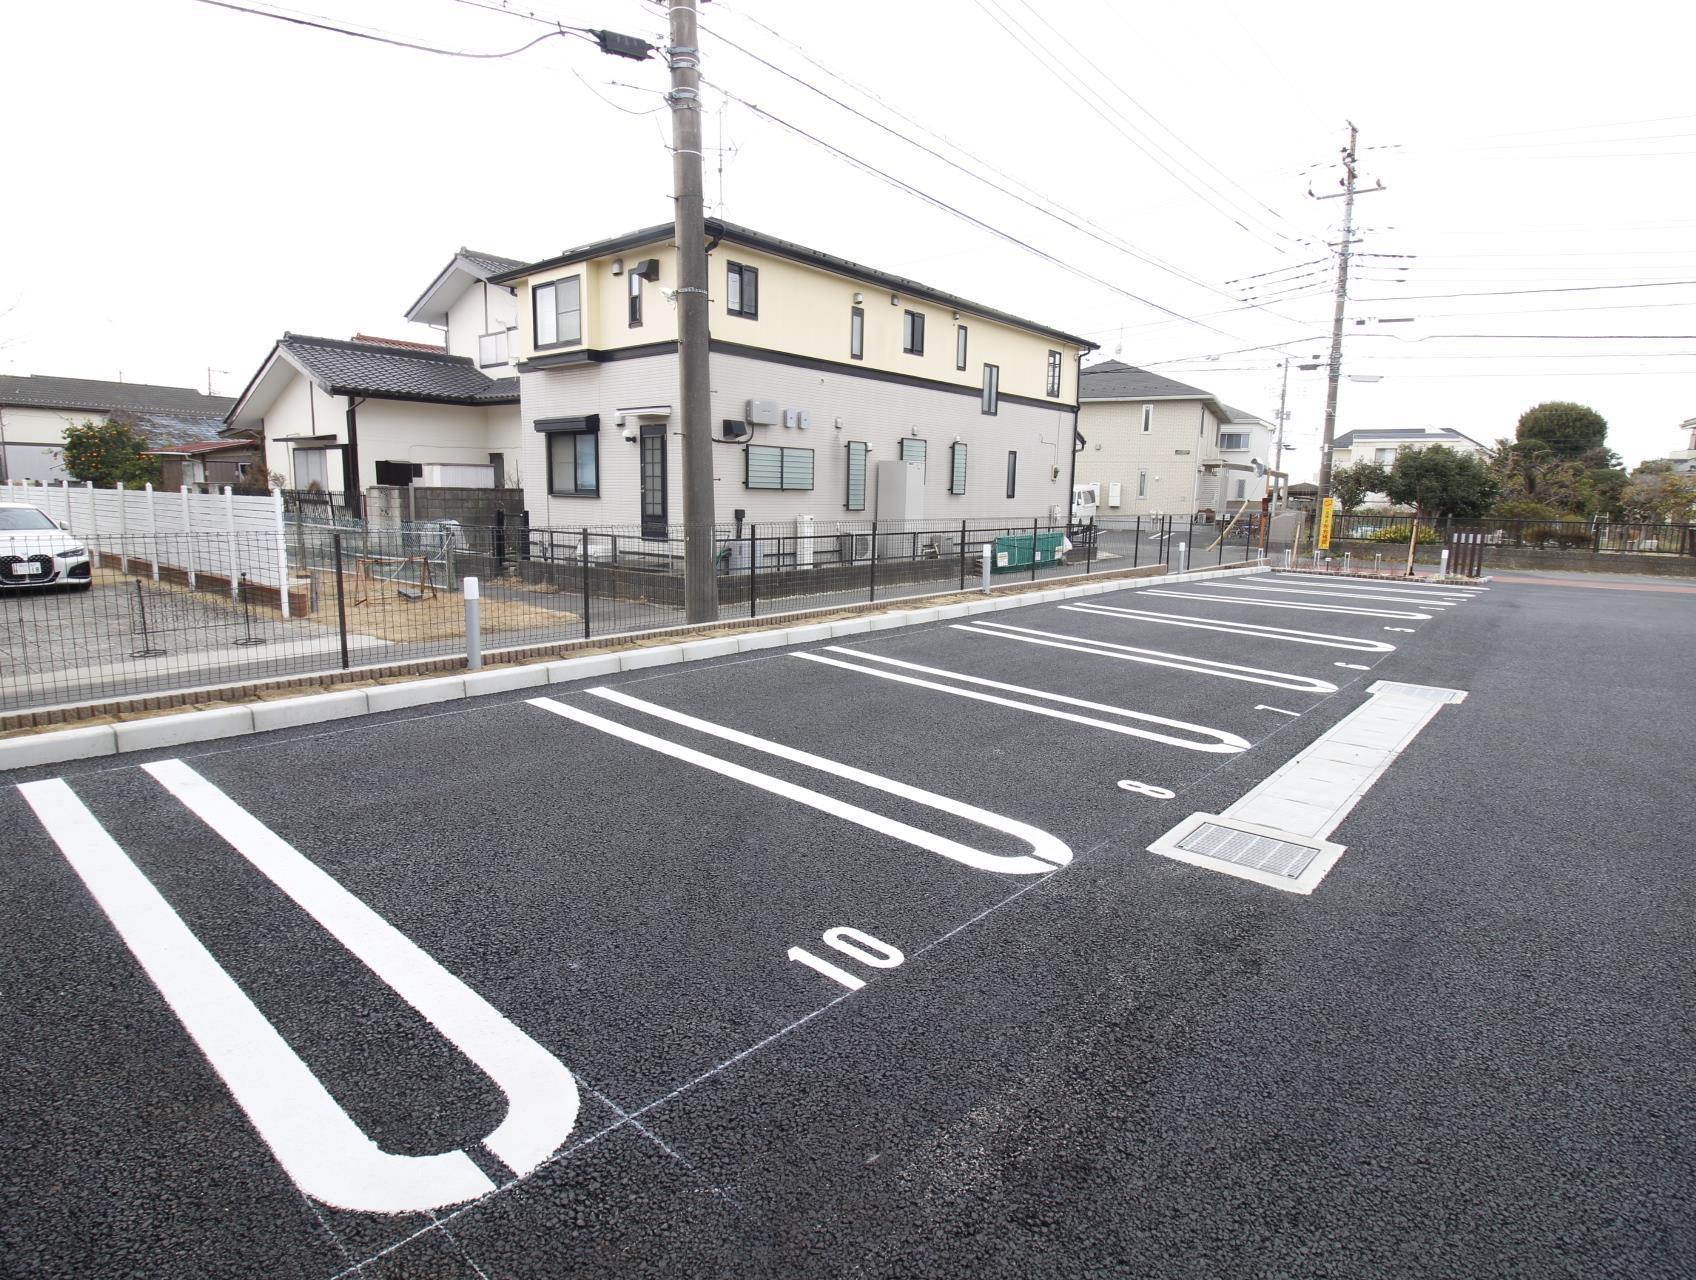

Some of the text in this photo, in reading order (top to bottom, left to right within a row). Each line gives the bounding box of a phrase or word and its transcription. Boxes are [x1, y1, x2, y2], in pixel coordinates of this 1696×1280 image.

[1333, 661, 1372, 671] 6
[1253, 704, 1302, 717] 7
[1116, 779, 1176, 800] 8
[787, 926, 905, 992] 10
